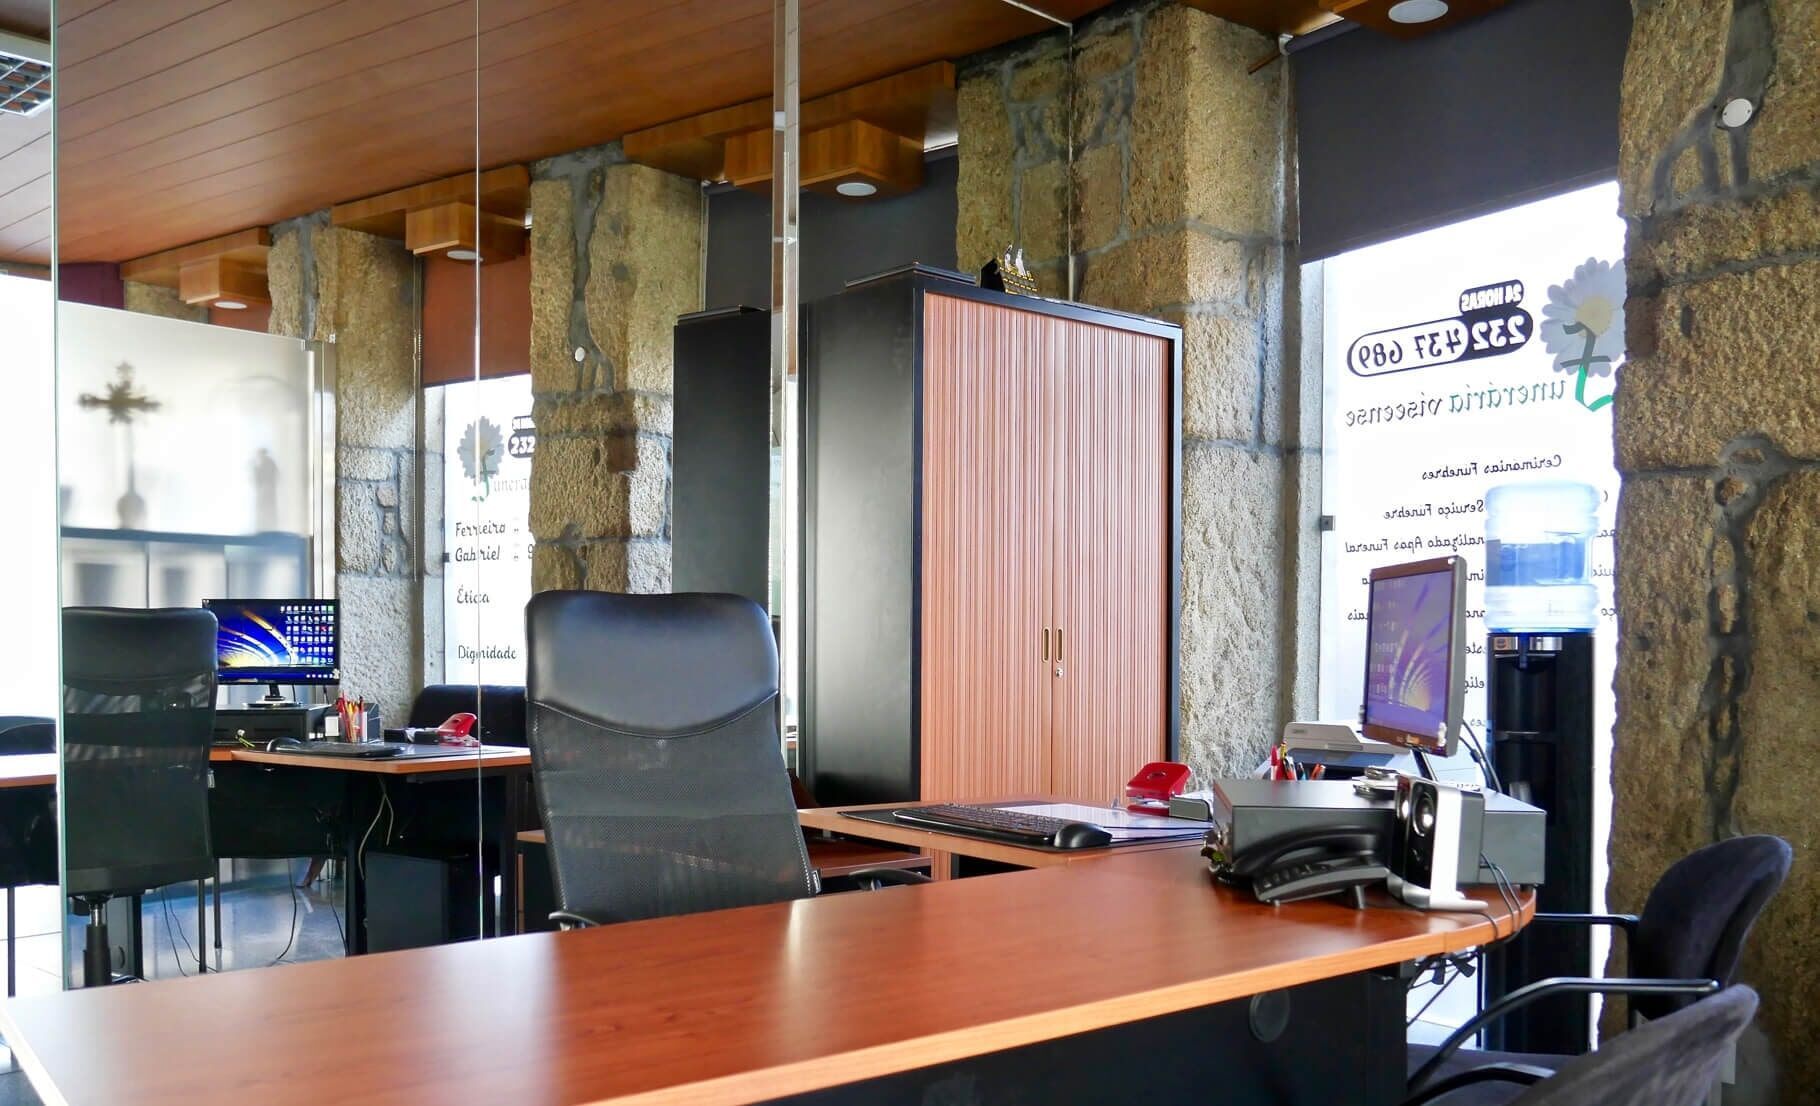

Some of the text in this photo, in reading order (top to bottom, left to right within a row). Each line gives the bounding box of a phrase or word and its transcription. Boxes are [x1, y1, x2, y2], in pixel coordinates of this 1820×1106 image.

[510, 436, 535, 456] 232
[455, 545, 501, 562] Gabriel
[456, 584, 490, 604] Ética
